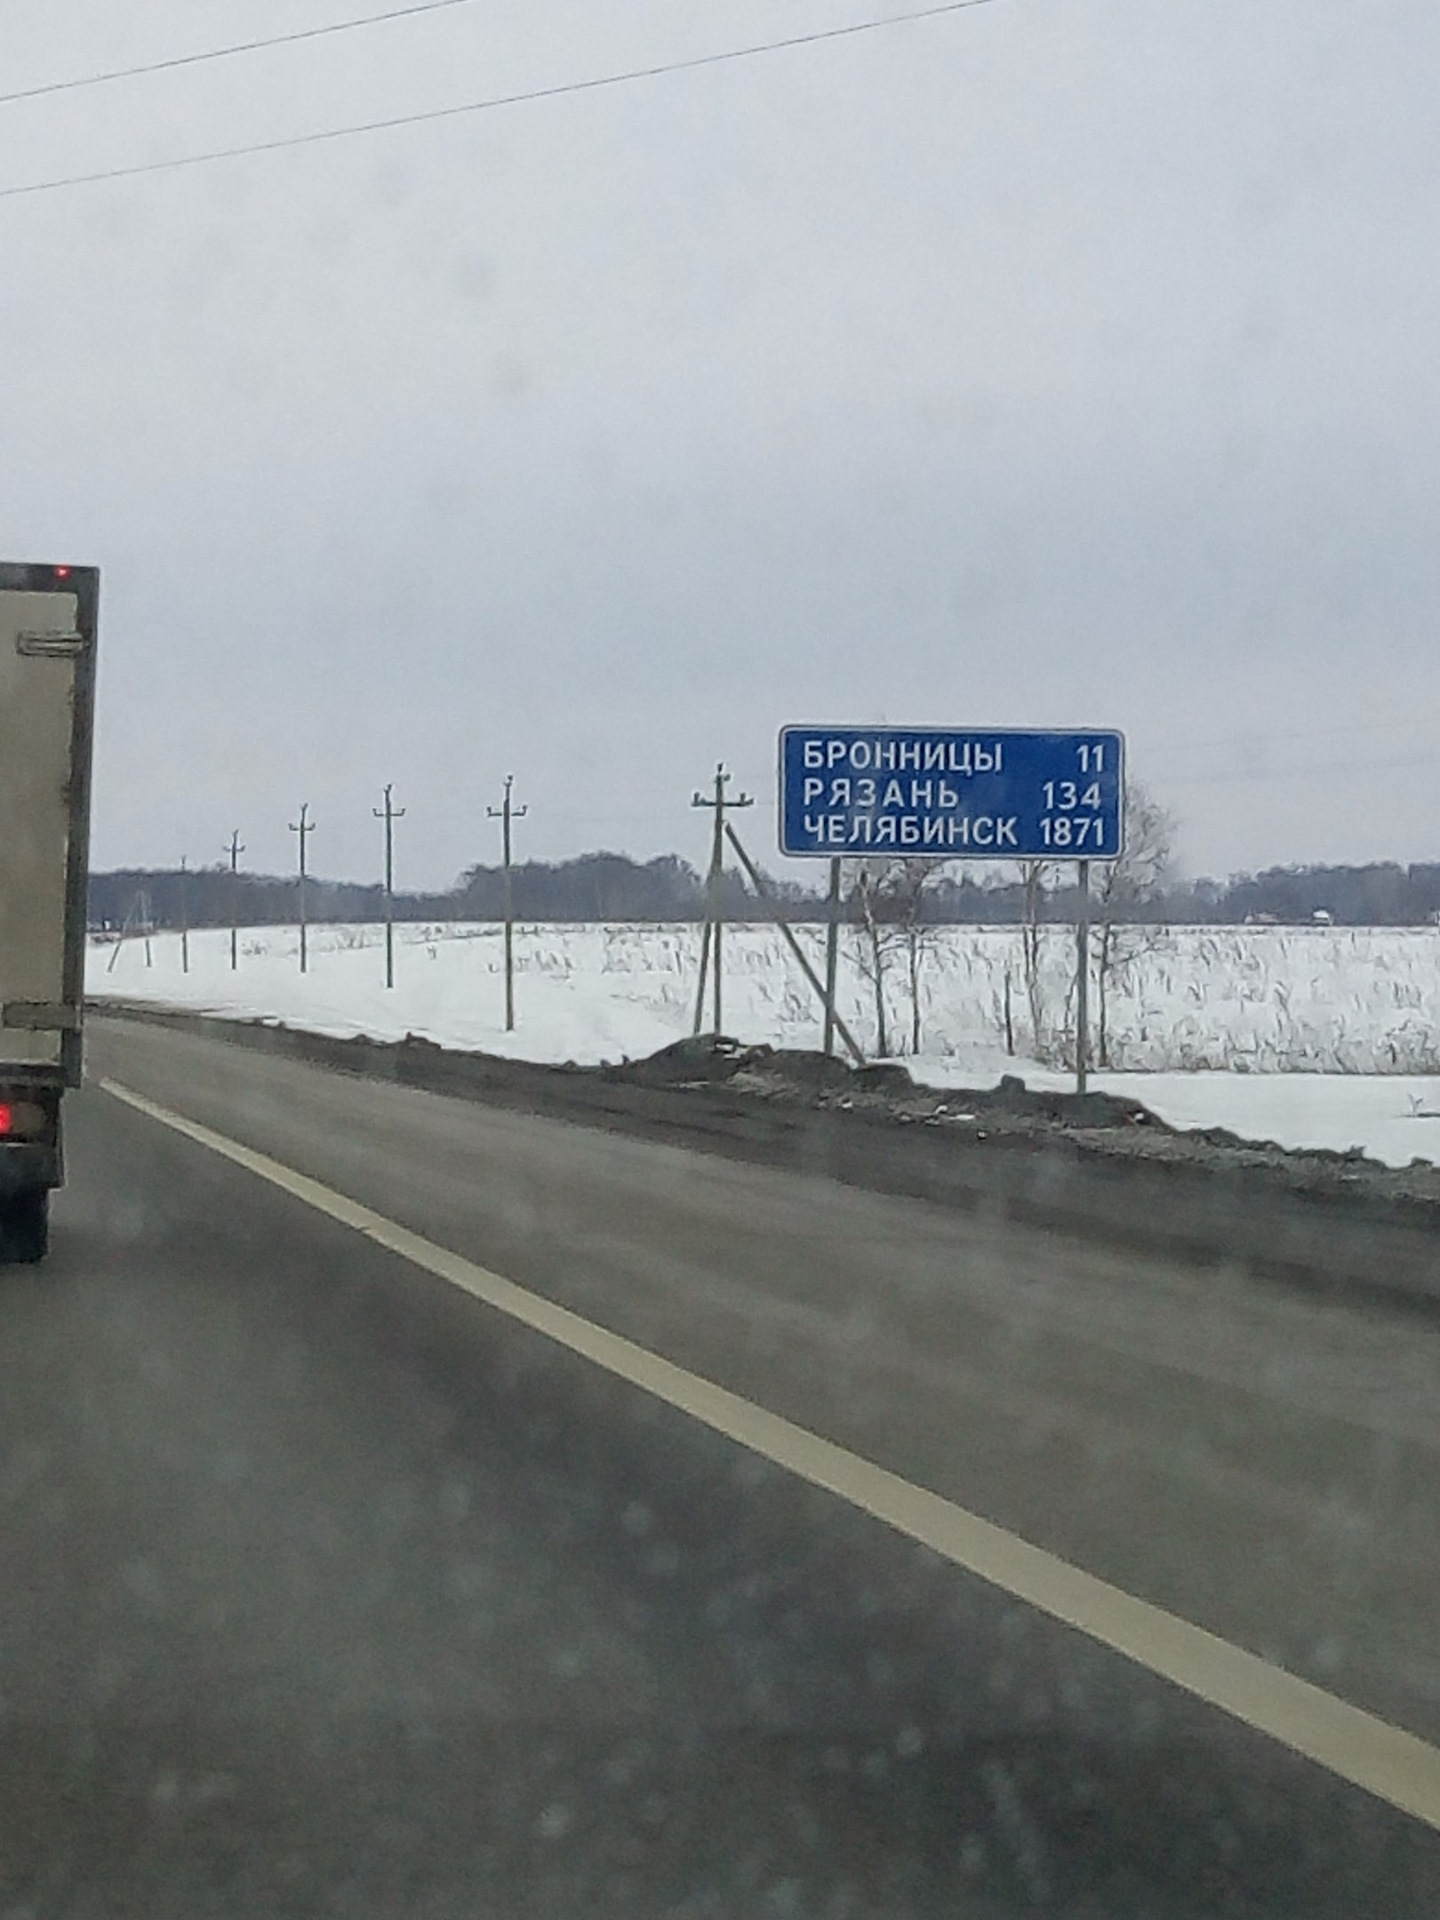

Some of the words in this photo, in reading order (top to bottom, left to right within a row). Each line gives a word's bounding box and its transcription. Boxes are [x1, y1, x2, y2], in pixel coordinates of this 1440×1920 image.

[803, 740, 1002, 776] БРОННИЦЫ
[1076, 744, 1104, 773] 11
[803, 778, 959, 809] РЯЗАНЬ
[1042, 782, 1102, 810] 134
[803, 814, 1018, 847] ЧЕЛЯБИНСК
[1039, 817, 1104, 847] 1871
